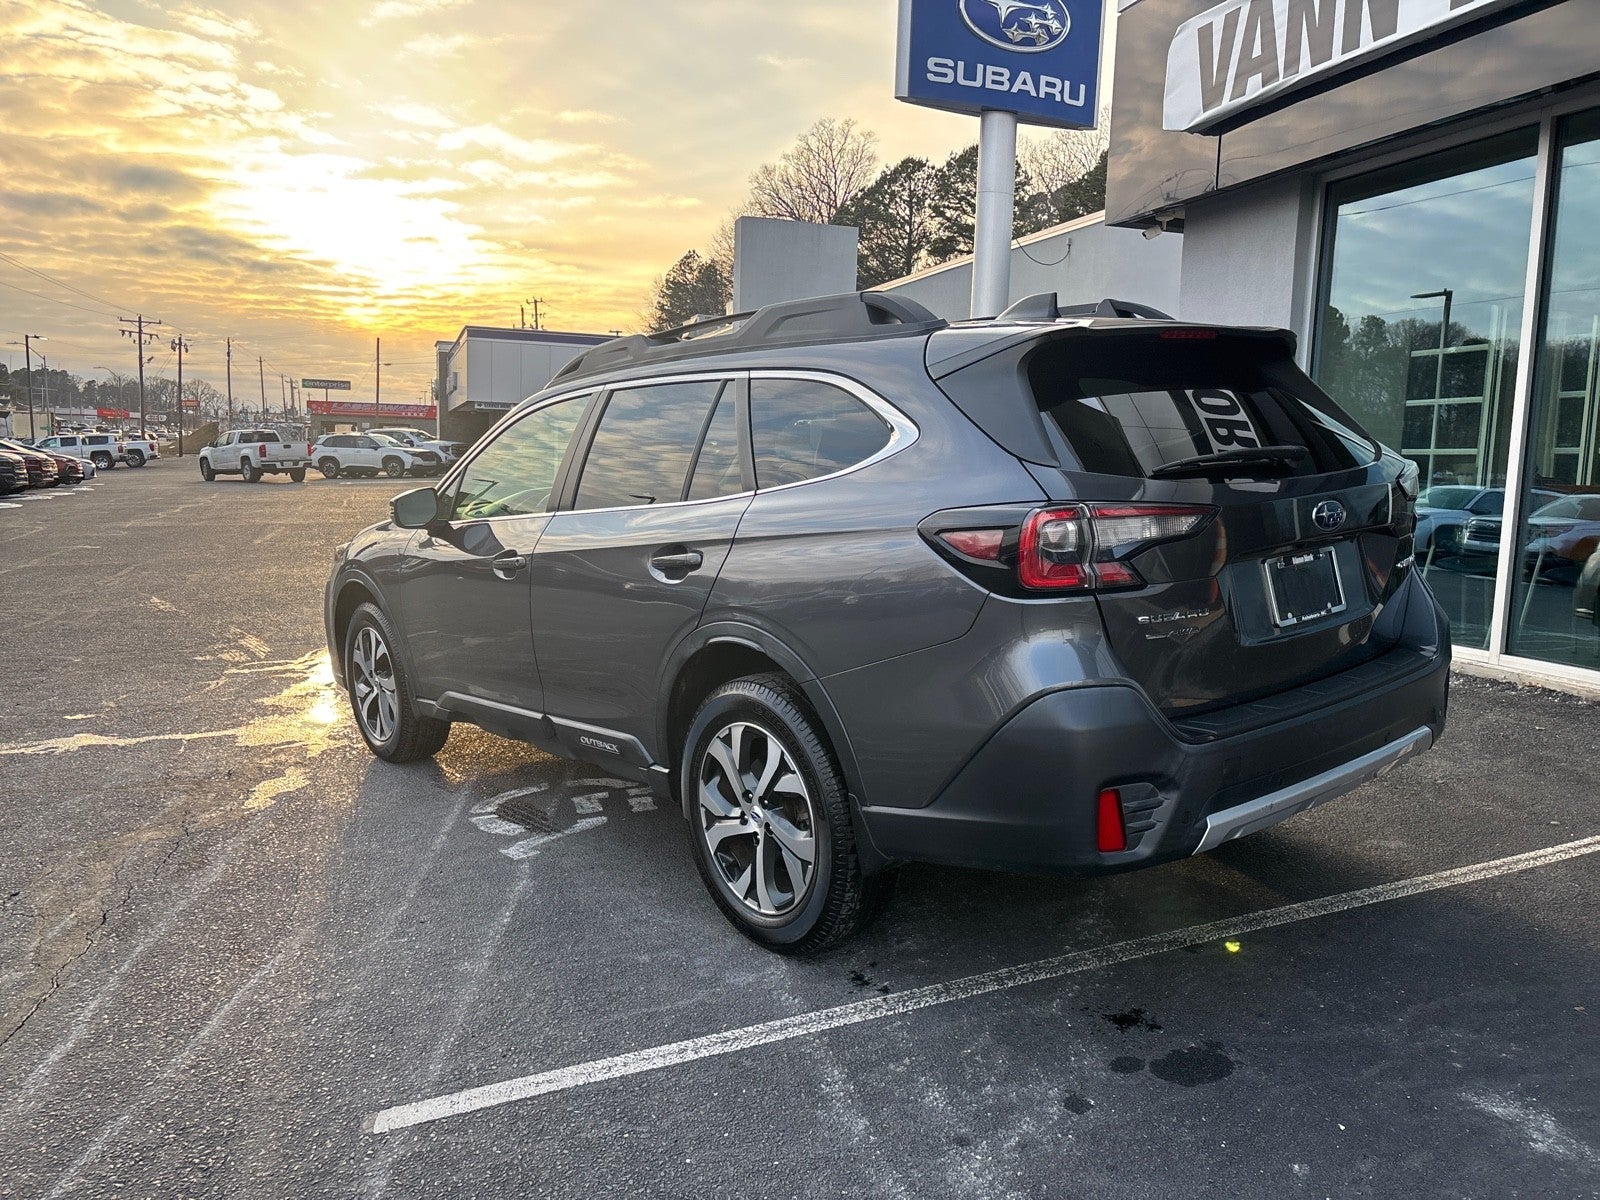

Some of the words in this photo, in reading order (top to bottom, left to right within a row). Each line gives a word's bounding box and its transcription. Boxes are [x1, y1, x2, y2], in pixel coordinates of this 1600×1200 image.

[927, 56, 1086, 107] SUBARU
[304, 380, 350, 388] enterprise
[1137, 608, 1210, 624] SUBARU
[580, 736, 619, 753] OUTBACK
